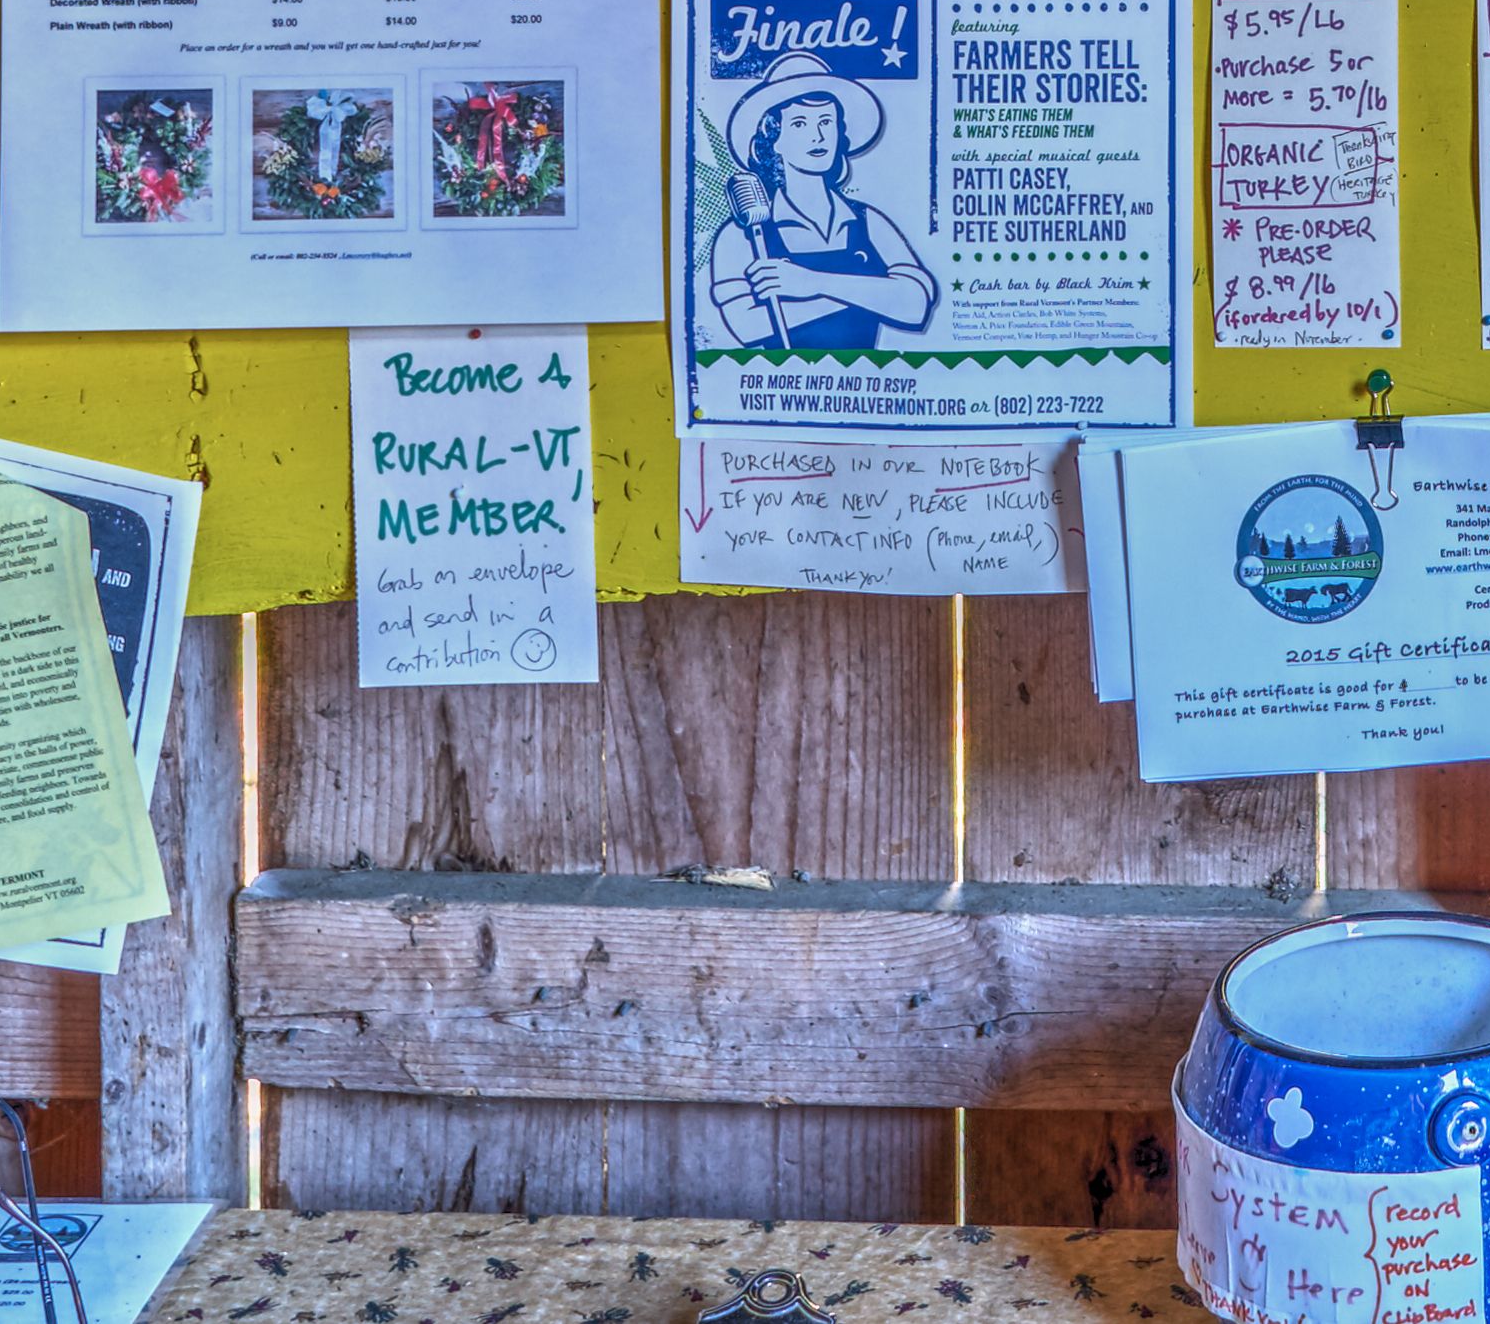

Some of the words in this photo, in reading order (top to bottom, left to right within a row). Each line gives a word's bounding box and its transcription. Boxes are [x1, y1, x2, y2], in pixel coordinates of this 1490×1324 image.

[952, 39, 1072, 70] FARMERS
[1080, 38, 1140, 69] TELL
[952, 73, 1027, 104] THEIR
[1035, 71, 1148, 104] STORIES:
[952, 168, 1004, 191] PATTI
[1010, 168, 1071, 193] CASEY,
[952, 195, 1007, 218] COLIN
[1013, 193, 1127, 219] MCCAFFREY,
[1130, 202, 1153, 217] AND
[952, 221, 998, 243] PETE
[1004, 221, 1127, 242] SUTHERLAND
[384, 352, 522, 396] Become
[740, 394, 777, 413] VISIT
[779, 394, 966, 416] WWW.RURALVERMONT.ORG
[970, 397, 990, 414] or
[995, 396, 1033, 416] (802)
[1037, 396, 1104, 415] 223-7222
[1285, 647, 1339, 664] 2015
[1348, 642, 1392, 664] Gift
